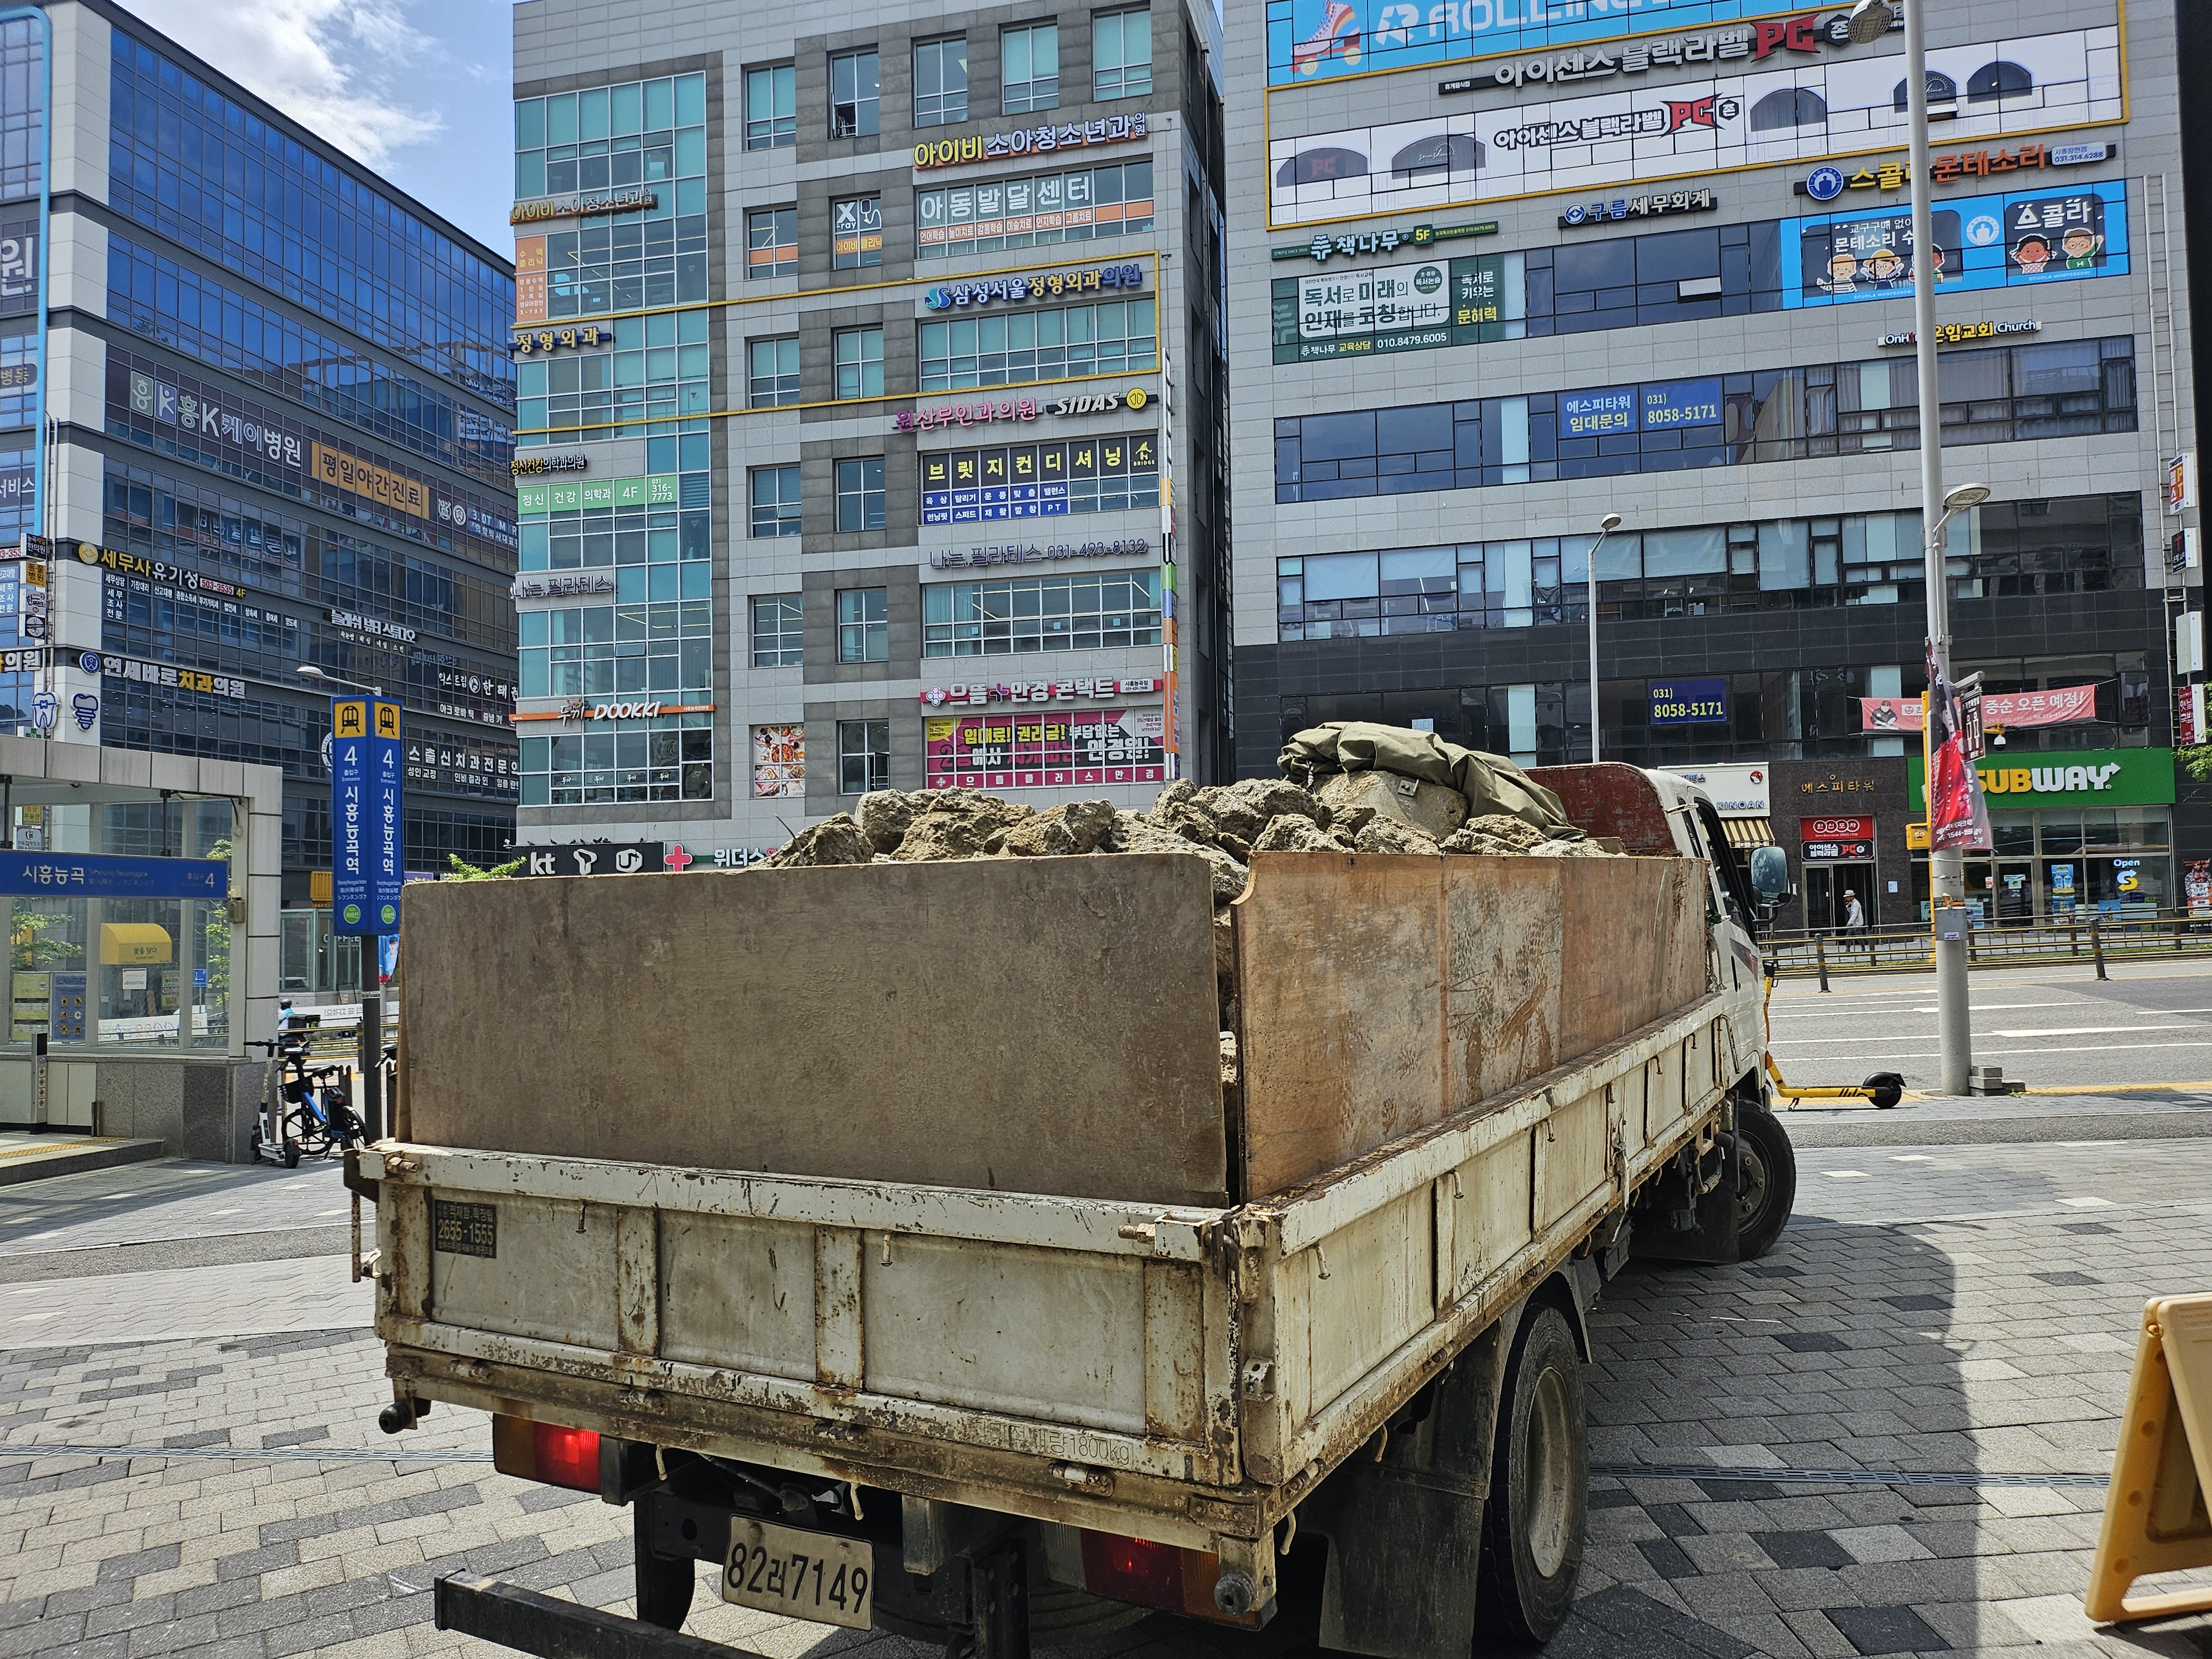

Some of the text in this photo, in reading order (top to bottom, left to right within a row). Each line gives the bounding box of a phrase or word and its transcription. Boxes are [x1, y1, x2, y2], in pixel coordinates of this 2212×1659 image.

[1444, 80, 1470, 90] 휴게음식점
[914, 134, 983, 166] 아이비
[986, 114, 1133, 157] 소아청소년과
[2054, 146, 2088, 156] 시흥장현점
[2054, 150, 2104, 163] 031.314.6288
[1934, 143, 2044, 184] 몬테소리
[512, 190, 644, 220] 아이비 소아청소년과
[921, 176, 1090, 220] 아동발달센터
[920, 228, 946, 241] 언어학습
[948, 225, 974, 238] 놀이치료
[1006, 218, 1032, 231] 미술치료
[1036, 214, 1062, 227] 인지학습
[1066, 210, 1092, 225] 그룹치료
[1849, 219, 1891, 234] 교구구매
[836, 241, 858, 252] 아이비
[1336, 229, 1400, 257] 책나무
[1415, 226, 1431, 242] 5F
[1834, 232, 1896, 252] 몬테소리
[1460, 271, 1494, 285] 독서로
[1304, 279, 1409, 308] 독서로 미래의
[1461, 285, 1495, 300] 키우는
[1305, 309, 1355, 332] 인재를
[1996, 319, 2037, 333] Church
[517, 325, 599, 354] 정형외과
[1311, 332, 1447, 356] 책나무 교육상담 010.8479.6005
[1054, 392, 1120, 416] SIDAS
[1566, 395, 1631, 414] 에스피타워
[1647, 393, 1667, 405] 031)
[1569, 412, 1628, 432] 임대문의
[1647, 404, 1717, 424] 8058-5171
[928, 447, 1121, 481] 브릿지컨디셔닝
[1133, 458, 1156, 467] BRIDGE
[322, 452, 421, 508] 평일야간진료
[522, 487, 638, 507] 정신 건강 의학과 4F
[651, 492, 672, 502] 7773
[954, 493, 977, 503] 달리기
[1044, 486, 1066, 496] 밸런스
[927, 512, 948, 523] 런닝핏
[954, 509, 977, 520] 스피드
[1047, 503, 1061, 512] PT
[1047, 538, 1147, 560] 031-493-8132
[105, 573, 126, 587] 세무상담
[130, 580, 149, 593] 기장대리
[154, 585, 173, 598] 신고대행
[107, 588, 123, 599] 세무
[201, 579, 247, 598] 503-3535 4F
[107, 599, 123, 609] 조사
[107, 609, 123, 620] 전문
[439, 671, 467, 688] 익스트림
[1010, 679, 1049, 703] 안경
[1055, 676, 1115, 701] 콘택트
[1652, 688, 1673, 700] 031)
[1984, 698, 2013, 715] 중순
[2017, 695, 2046, 712] 오픈
[2049, 691, 2085, 708] 예정!
[594, 701, 661, 721] DOOKKI
[1653, 701, 1723, 718] 8058-5171
[2180, 712, 2194, 724] 국밥
[963, 727, 1011, 745] 임대료!
[1016, 723, 1066, 743] 권리금!
[1069, 723, 1120, 740] 부담없는
[344, 745, 358, 766] 4
[383, 749, 394, 769] 4
[408, 766, 436, 780] 성인교정
[1978, 762, 2121, 794] SUBWAY
[1800, 779, 1875, 795] 에스피타워
[1716, 800, 1764, 810] KINOAN
[345, 785, 359, 875] 시흥능곡역
[382, 788, 395, 877] 시흥능곡역
[530, 852, 556, 875] kt
[2113, 859, 2140, 868] Open
[22, 864, 85, 885] 시흥능곡
[205, 873, 215, 888] 4
[438, 1218, 494, 1245] 2655-1555
[1070, 1436, 1130, 1465] 1800kg
